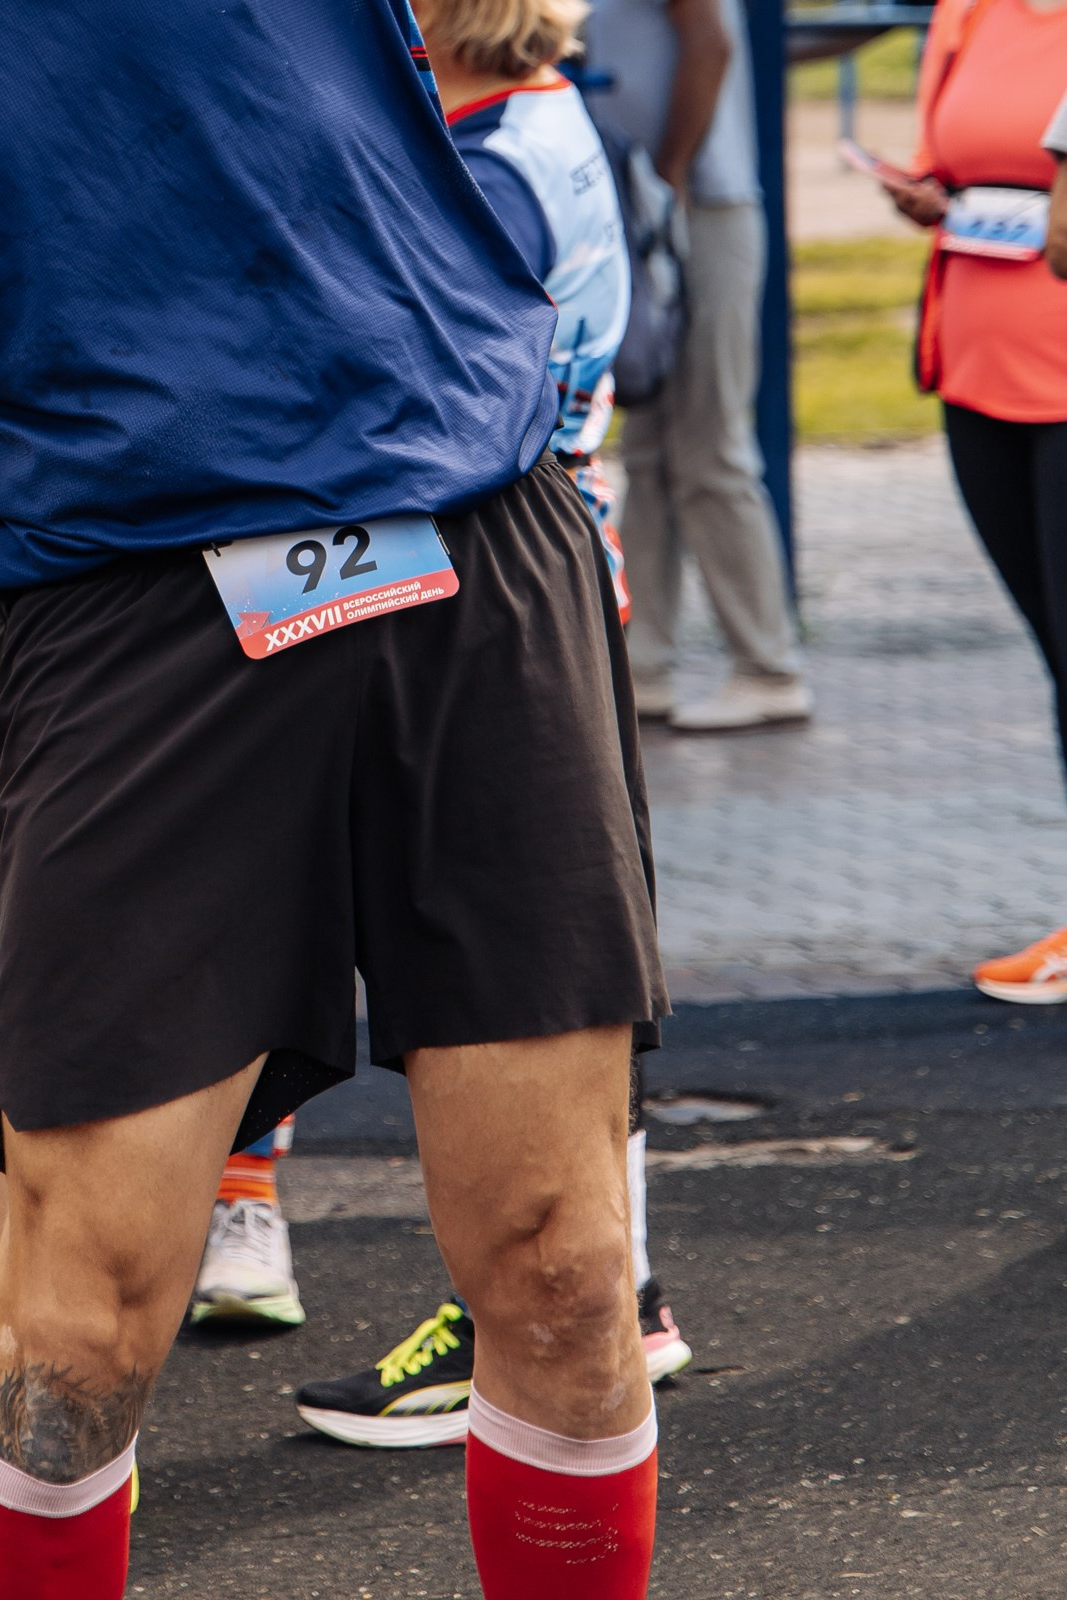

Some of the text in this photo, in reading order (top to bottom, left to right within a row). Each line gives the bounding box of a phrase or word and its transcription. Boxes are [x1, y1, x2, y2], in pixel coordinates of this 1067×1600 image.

[286, 525, 377, 595] 92
[342, 581, 421, 611] ВСЕРОССИЙСКИЙ
[346, 587, 445, 620] ОЛИМПИЙСКИЙ ДЕНЬ
[264, 605, 342, 652] XXXVII
